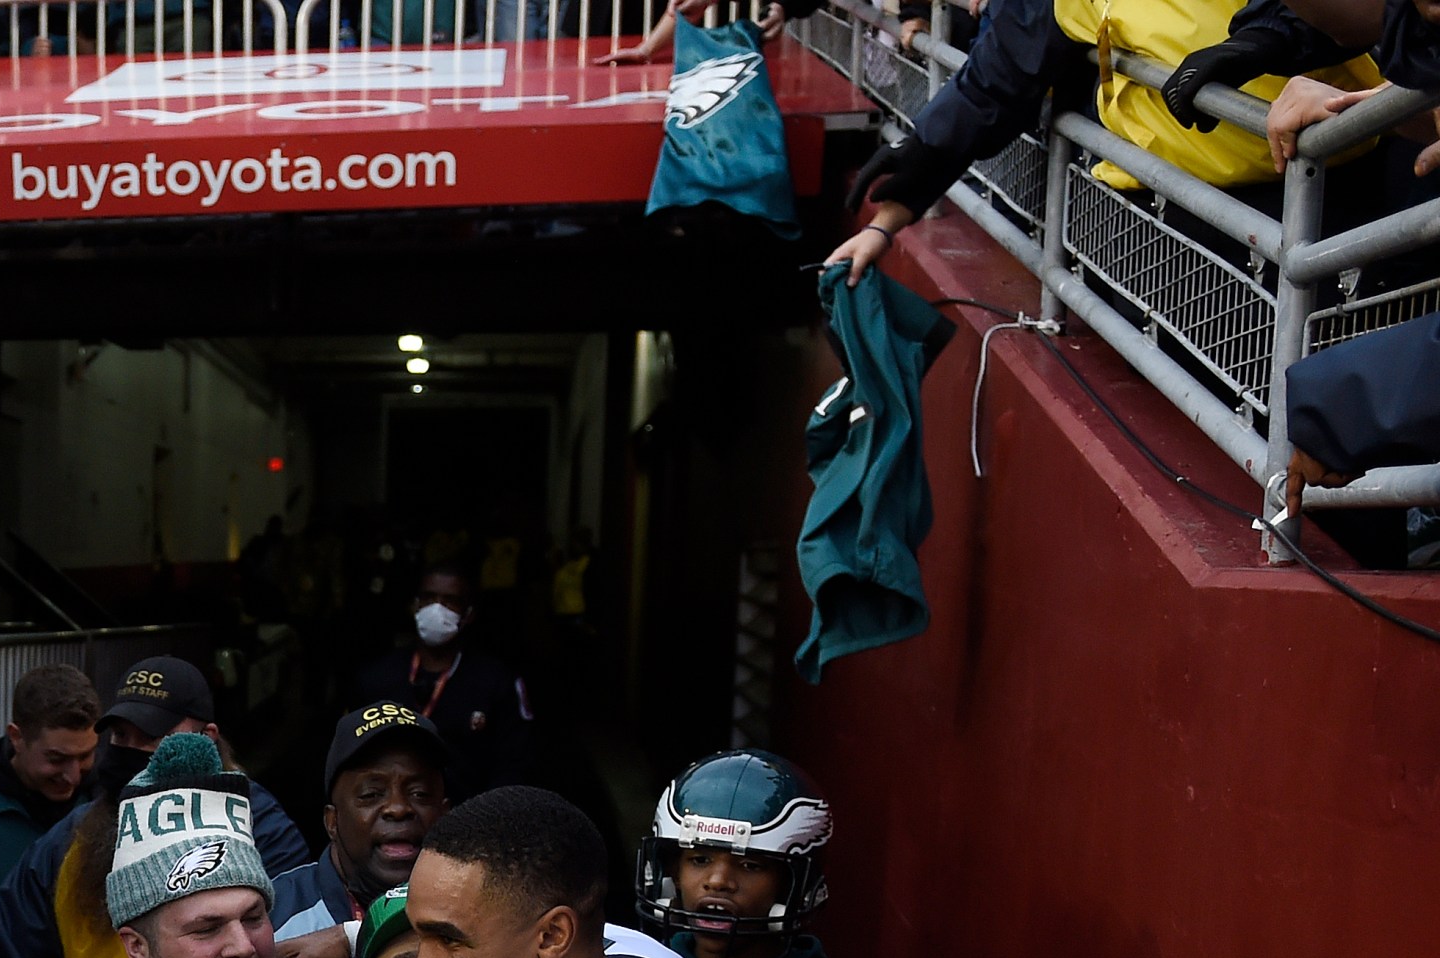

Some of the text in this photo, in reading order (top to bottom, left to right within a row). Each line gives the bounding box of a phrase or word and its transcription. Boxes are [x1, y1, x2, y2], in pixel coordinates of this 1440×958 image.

[12, 149, 457, 209] buyatoyota.com
[126, 670, 164, 687] CSC
[363, 704, 416, 720] CSC
[355, 716, 394, 737] EVENT
[116, 792, 254, 849] AGLE
[696, 821, 736, 836] Riddell
